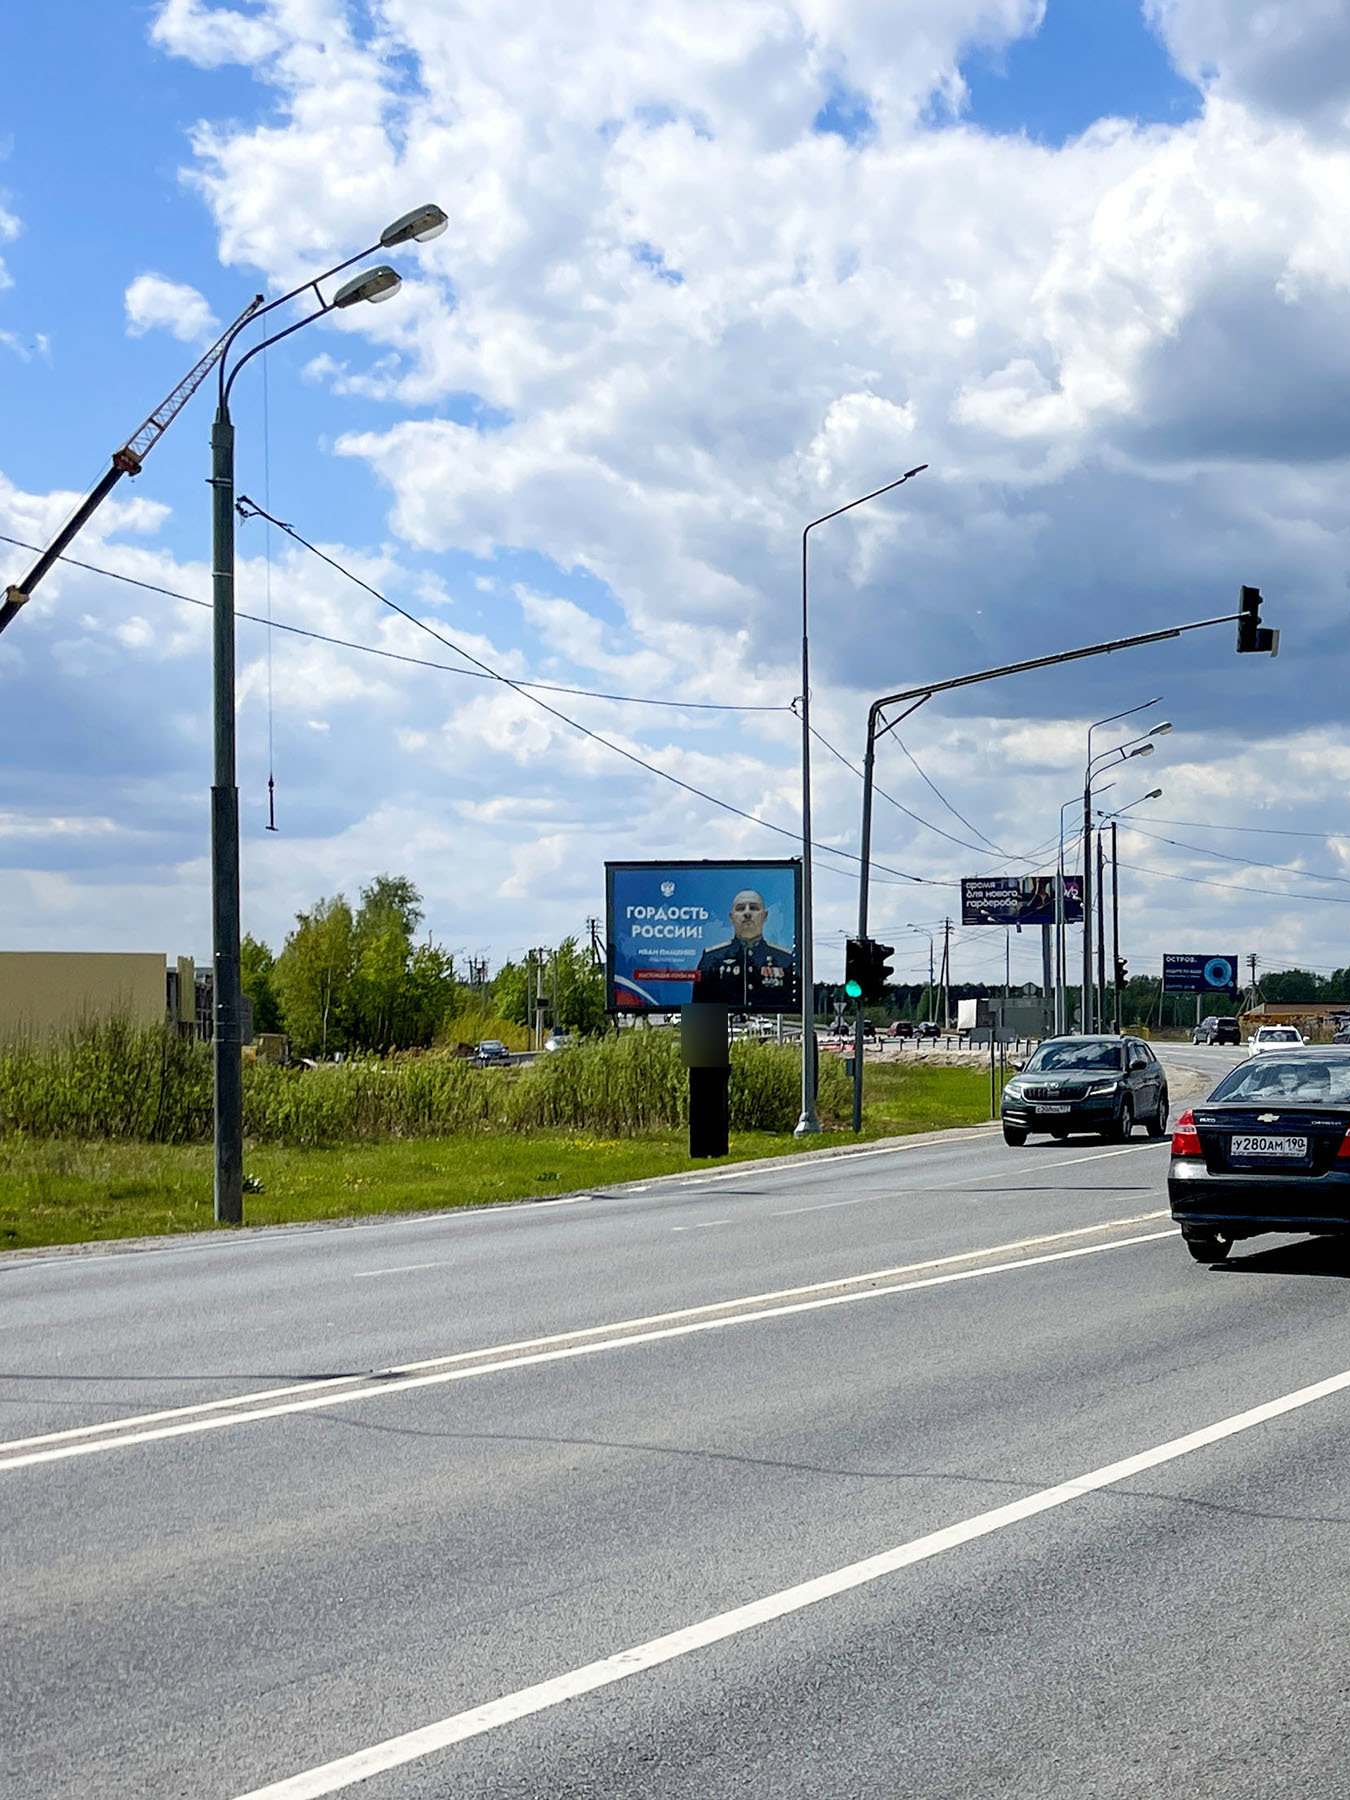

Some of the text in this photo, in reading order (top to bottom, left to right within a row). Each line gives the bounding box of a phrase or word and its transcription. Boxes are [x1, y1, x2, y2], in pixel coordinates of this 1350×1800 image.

[966, 889, 1018, 898] для нового
[966, 898, 1018, 908] гардероба
[626, 906, 709, 920] ГОРДОСТЬ
[632, 925, 703, 938] РОССИИ!
